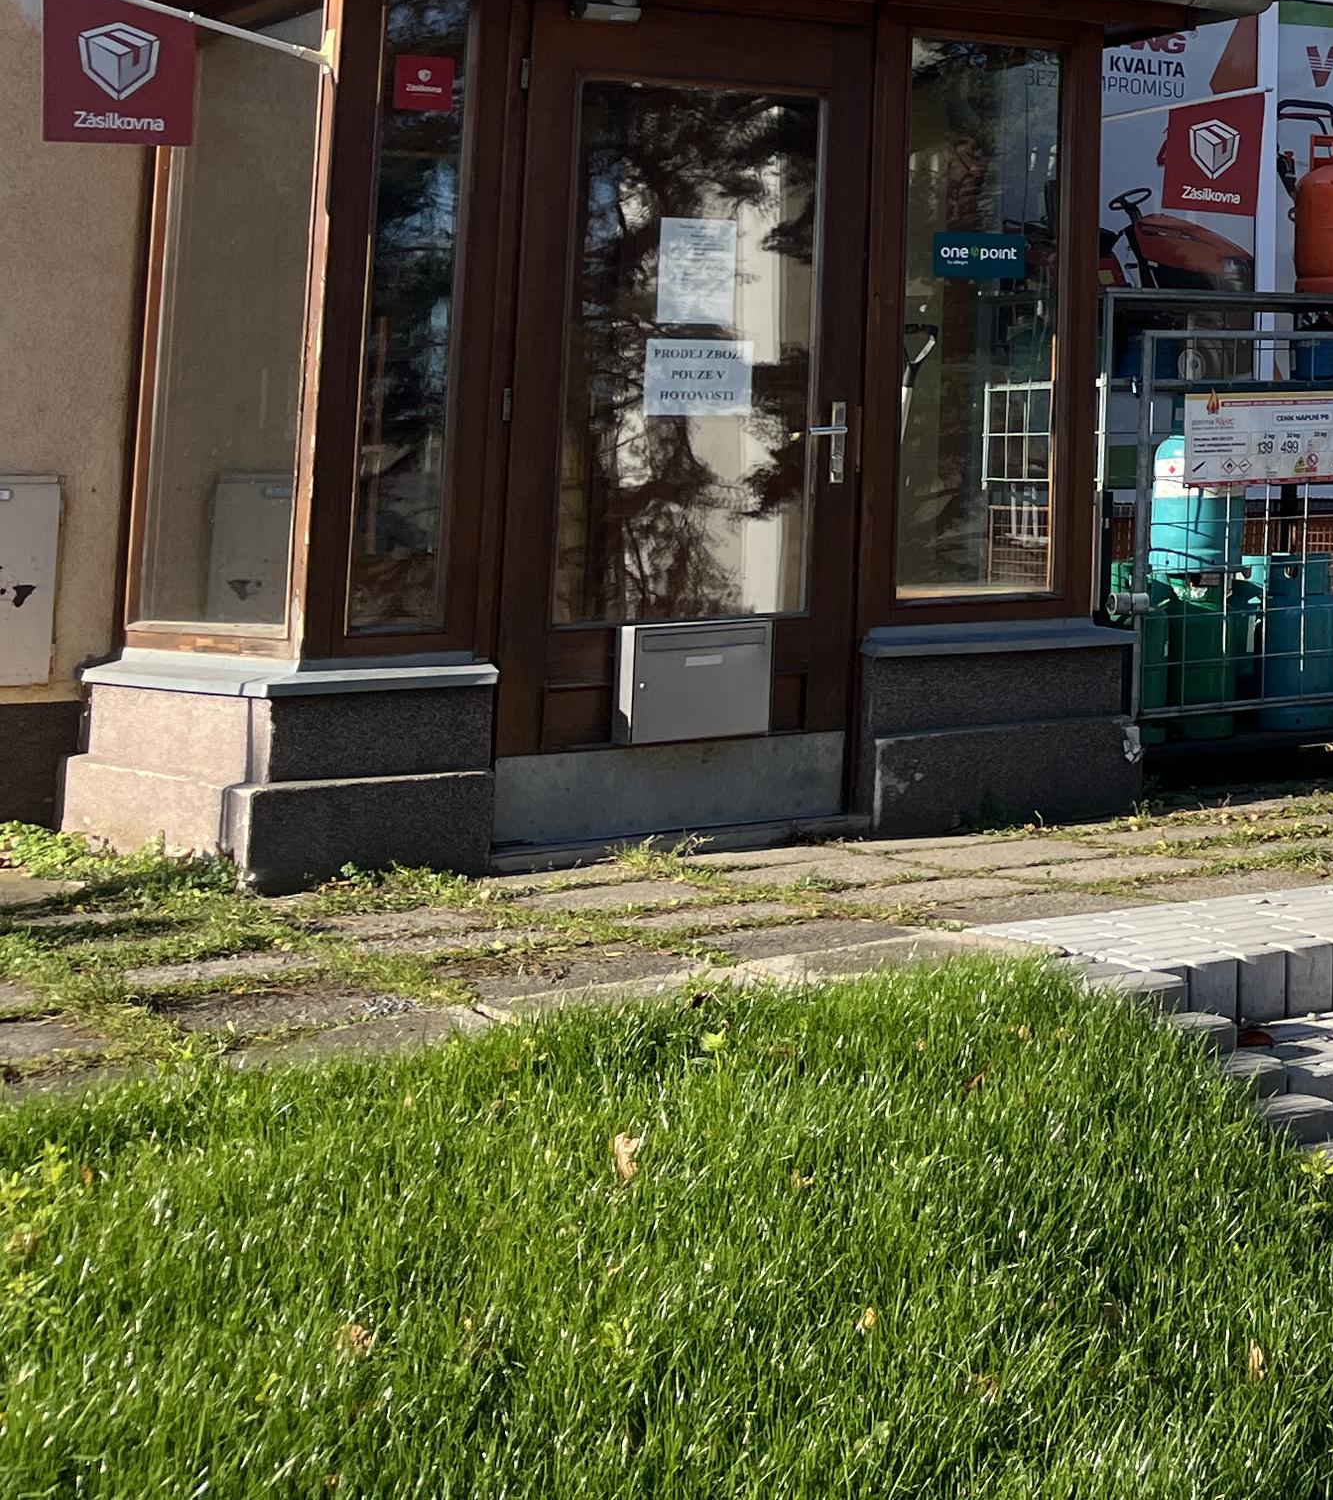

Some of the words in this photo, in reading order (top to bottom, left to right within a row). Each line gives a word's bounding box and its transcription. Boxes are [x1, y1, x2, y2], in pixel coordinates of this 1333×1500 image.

[1110, 55, 1185, 78] KVALITA
[74, 110, 165, 133] Zásilkovna
[1181, 186, 1240, 204] Zásilkovna
[940, 246, 969, 258] one
[980, 247, 1017, 260] point
[654, 350, 702, 360] PRODEJ
[671, 370, 714, 380] POUZE
[716, 370, 726, 380] V
[659, 390, 735, 401] HOTOVOSTI
[1257, 441, 1274, 455] 139
[1280, 440, 1300, 454] 499
